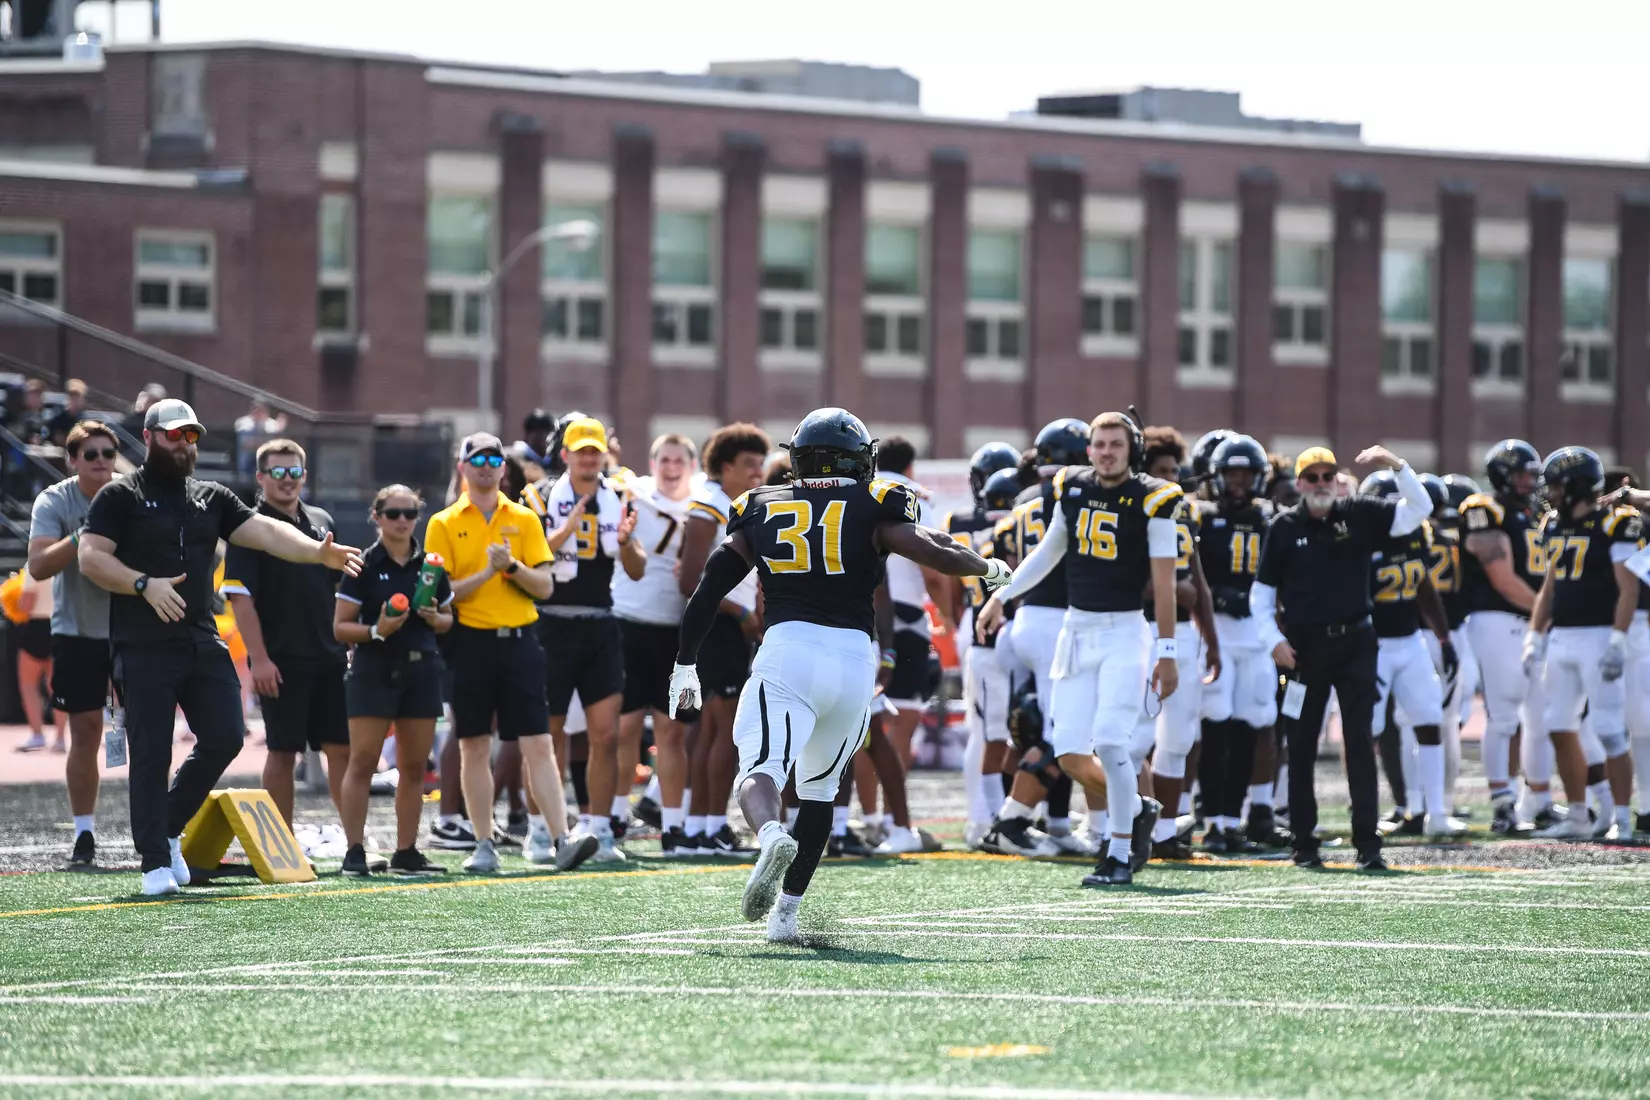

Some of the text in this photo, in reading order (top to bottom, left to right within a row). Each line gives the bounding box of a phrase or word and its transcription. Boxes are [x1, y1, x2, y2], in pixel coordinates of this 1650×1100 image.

[760, 500, 848, 575] 31
[1075, 507, 1119, 560] 16
[1229, 531, 1261, 574] 11
[1374, 559, 1425, 602] 20
[1547, 536, 1590, 580] 27
[239, 800, 300, 870] 20
